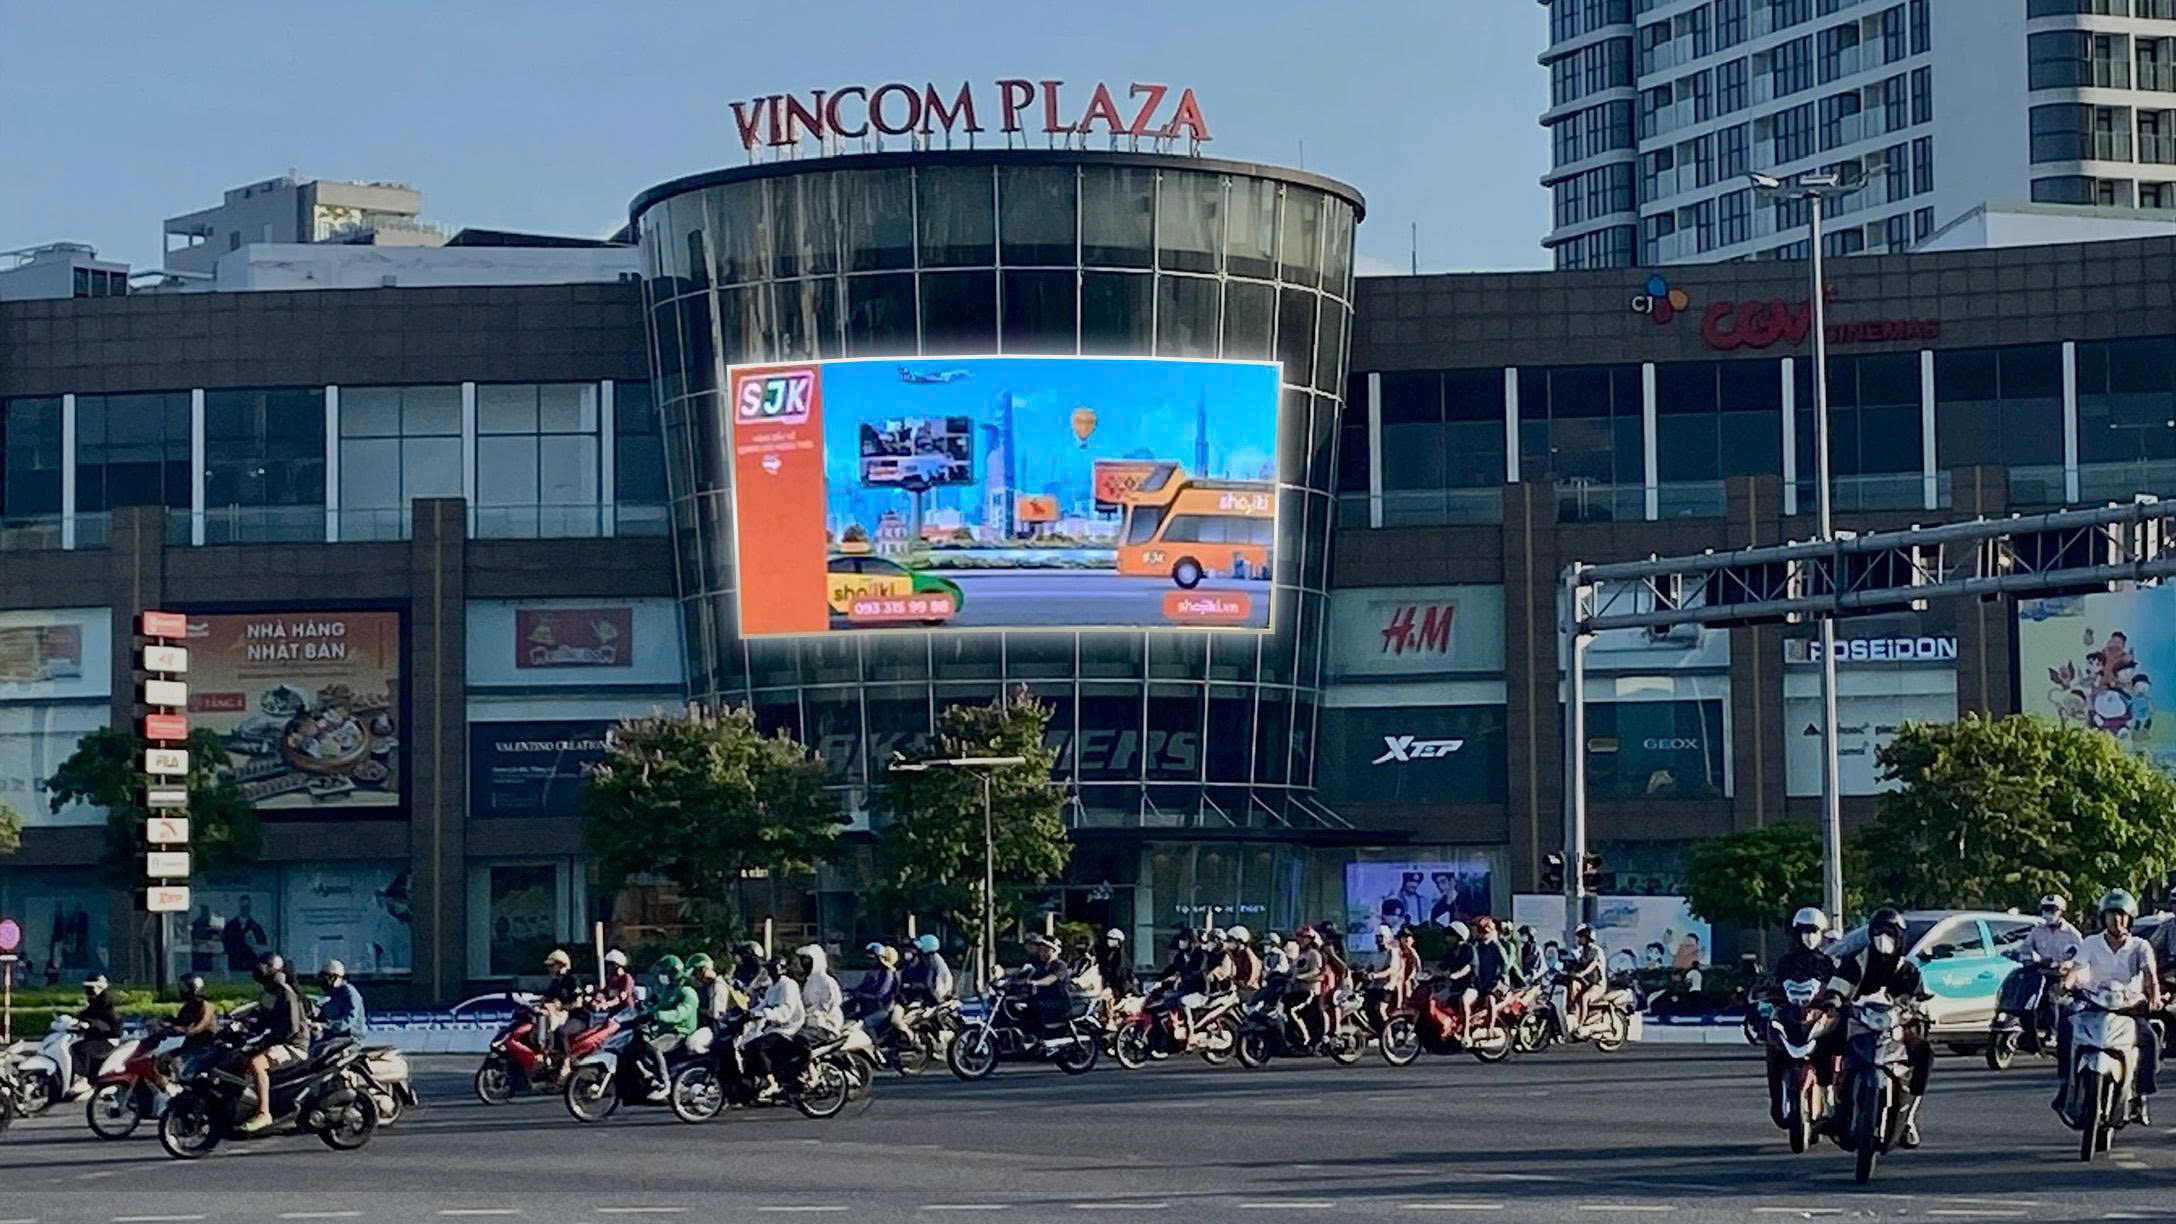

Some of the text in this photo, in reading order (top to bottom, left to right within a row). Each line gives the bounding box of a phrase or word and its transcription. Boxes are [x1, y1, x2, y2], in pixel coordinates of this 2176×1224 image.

[729, 79, 1213, 150] VINCOM PLAZA
[1631, 295, 1654, 314] CJ
[1700, 297, 1812, 350] CGV
[740, 377, 810, 416] SJK
[1380, 605, 1456, 656] H&M
[496, 741, 554, 752] VALENTINO
[822, 729, 1200, 780] SKERS
[1643, 738, 1699, 751] GEOX
